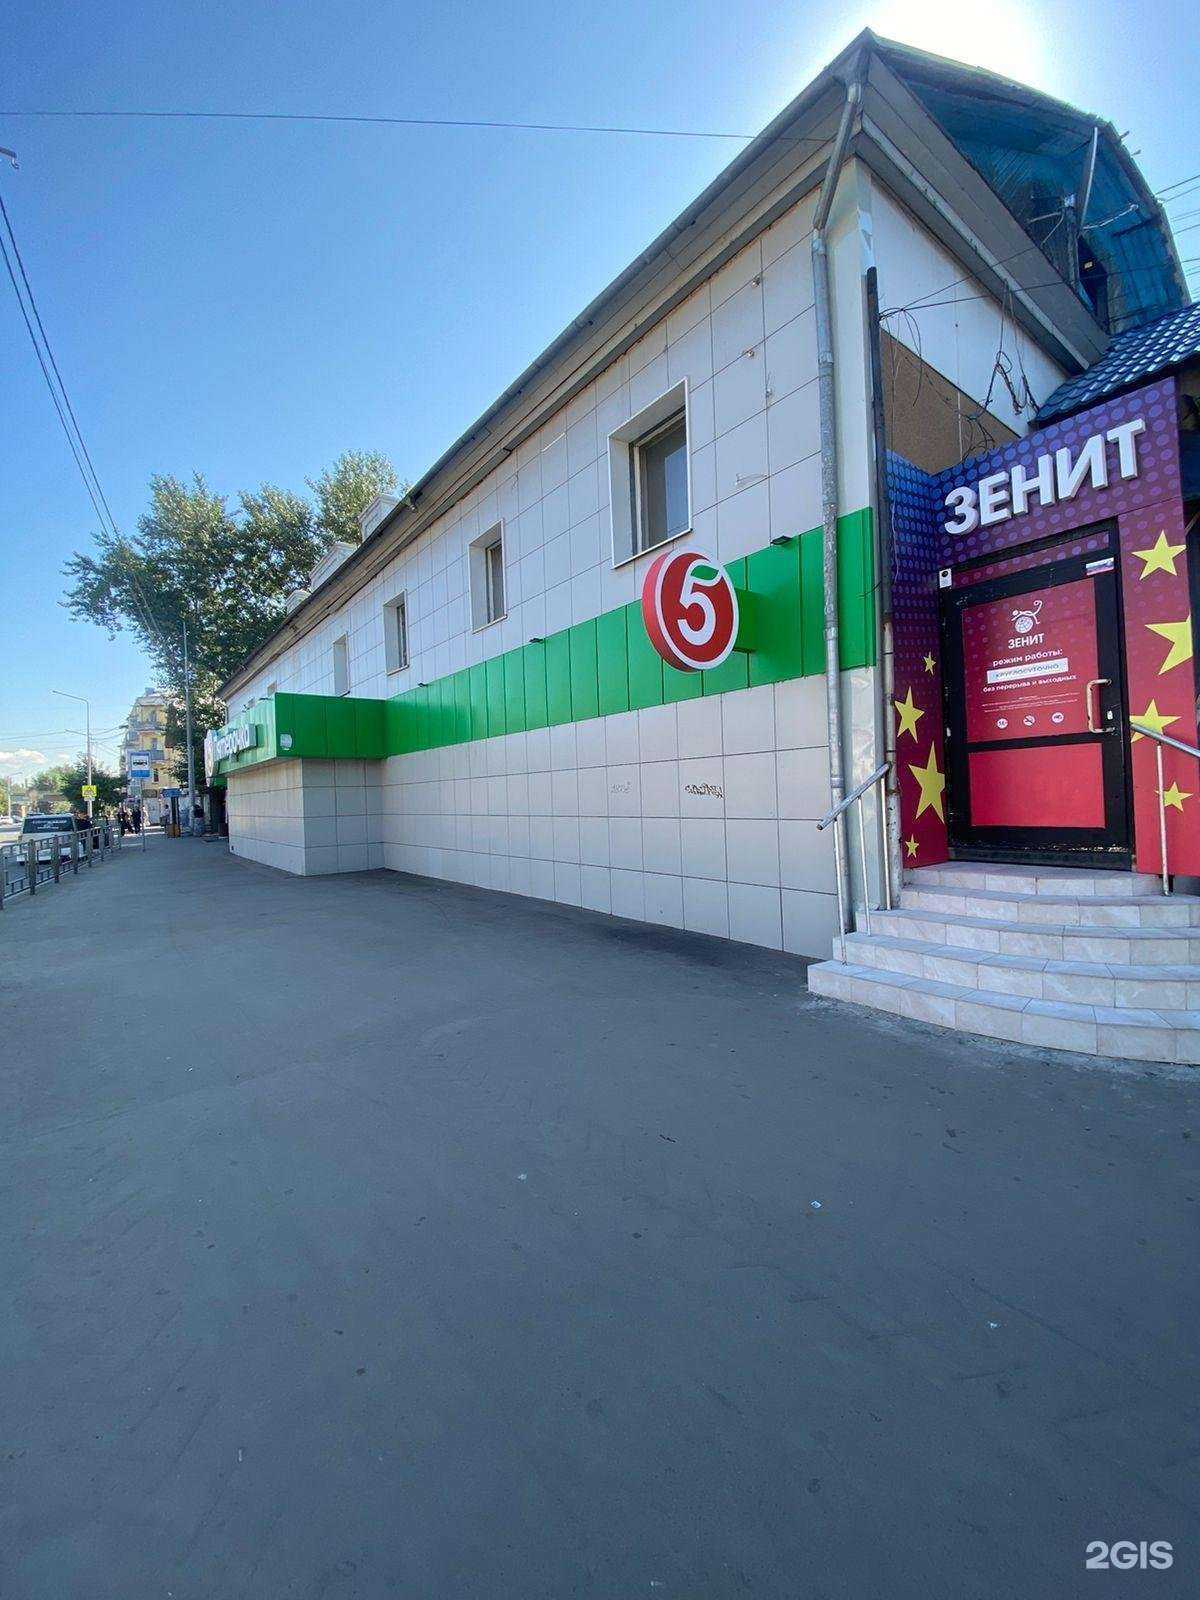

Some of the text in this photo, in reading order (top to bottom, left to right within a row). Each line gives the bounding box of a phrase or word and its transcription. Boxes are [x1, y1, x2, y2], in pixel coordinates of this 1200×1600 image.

[944, 418, 1146, 535] ЗЕНИТ
[677, 557, 722, 646] 5
[1008, 633, 1045, 649] ЗЕНИТ
[993, 649, 1063, 667] режим работы:
[983, 684, 995, 693] без
[996, 681, 1030, 691] перерыва
[1039, 675, 1077, 685] выходных
